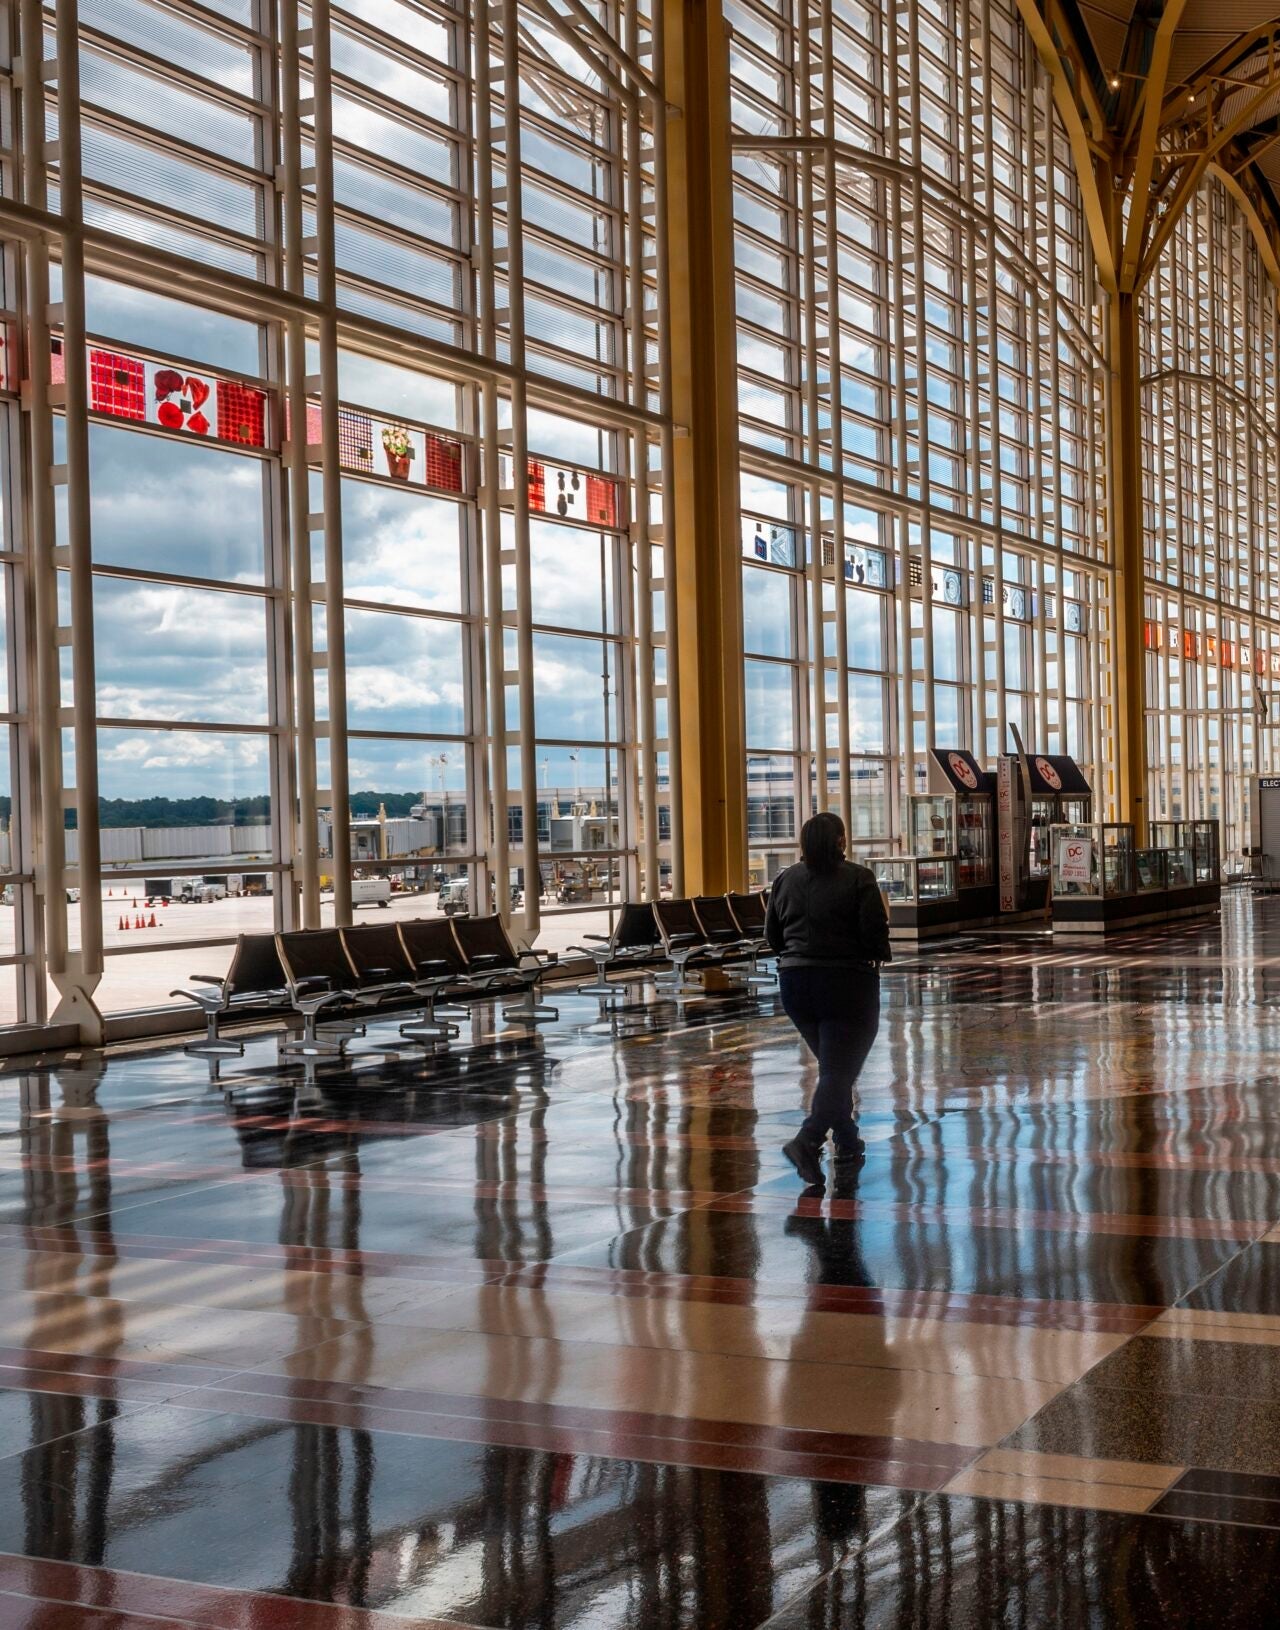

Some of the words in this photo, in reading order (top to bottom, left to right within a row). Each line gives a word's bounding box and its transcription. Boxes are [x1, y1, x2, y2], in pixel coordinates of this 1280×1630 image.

[953, 760, 970, 778] DC
[1040, 764, 1055, 780] DC
[1068, 846, 1083, 857] DC
